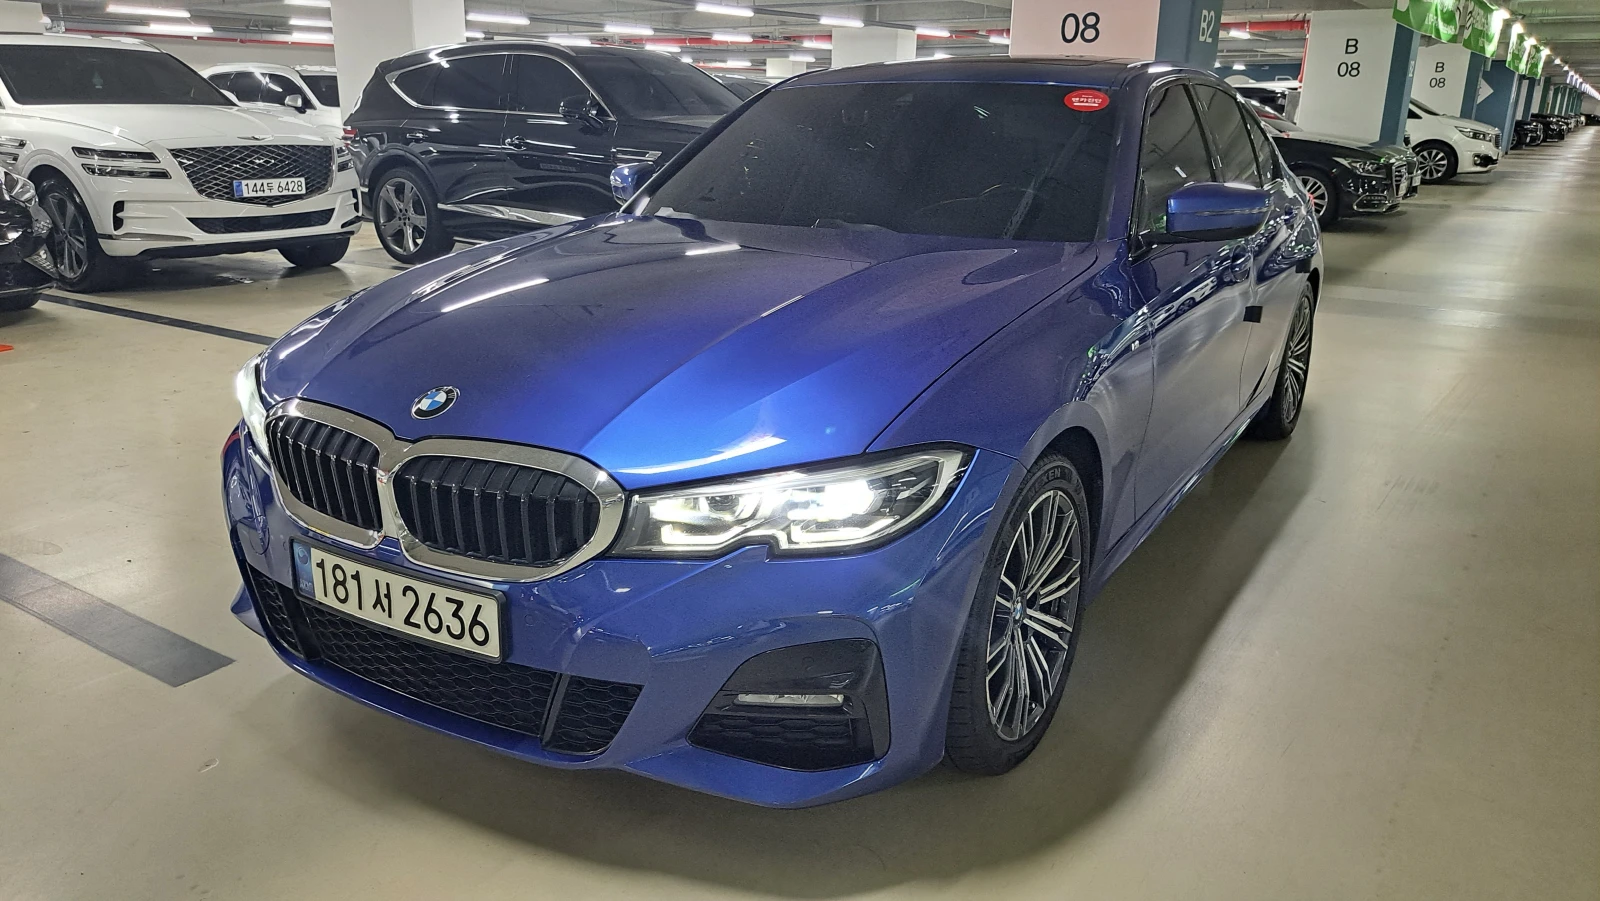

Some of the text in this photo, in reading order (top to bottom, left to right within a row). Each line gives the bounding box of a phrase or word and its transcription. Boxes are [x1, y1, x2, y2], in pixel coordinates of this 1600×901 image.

[1061, 12, 1100, 44] 08
[1199, 10, 1215, 43] B2
[1345, 38, 1359, 54] B
[1337, 61, 1361, 77] 08
[1434, 61, 1445, 73] B
[1429, 77, 1446, 88] 08
[277, 180, 304, 193] 6428
[402, 585, 490, 647] 2636
